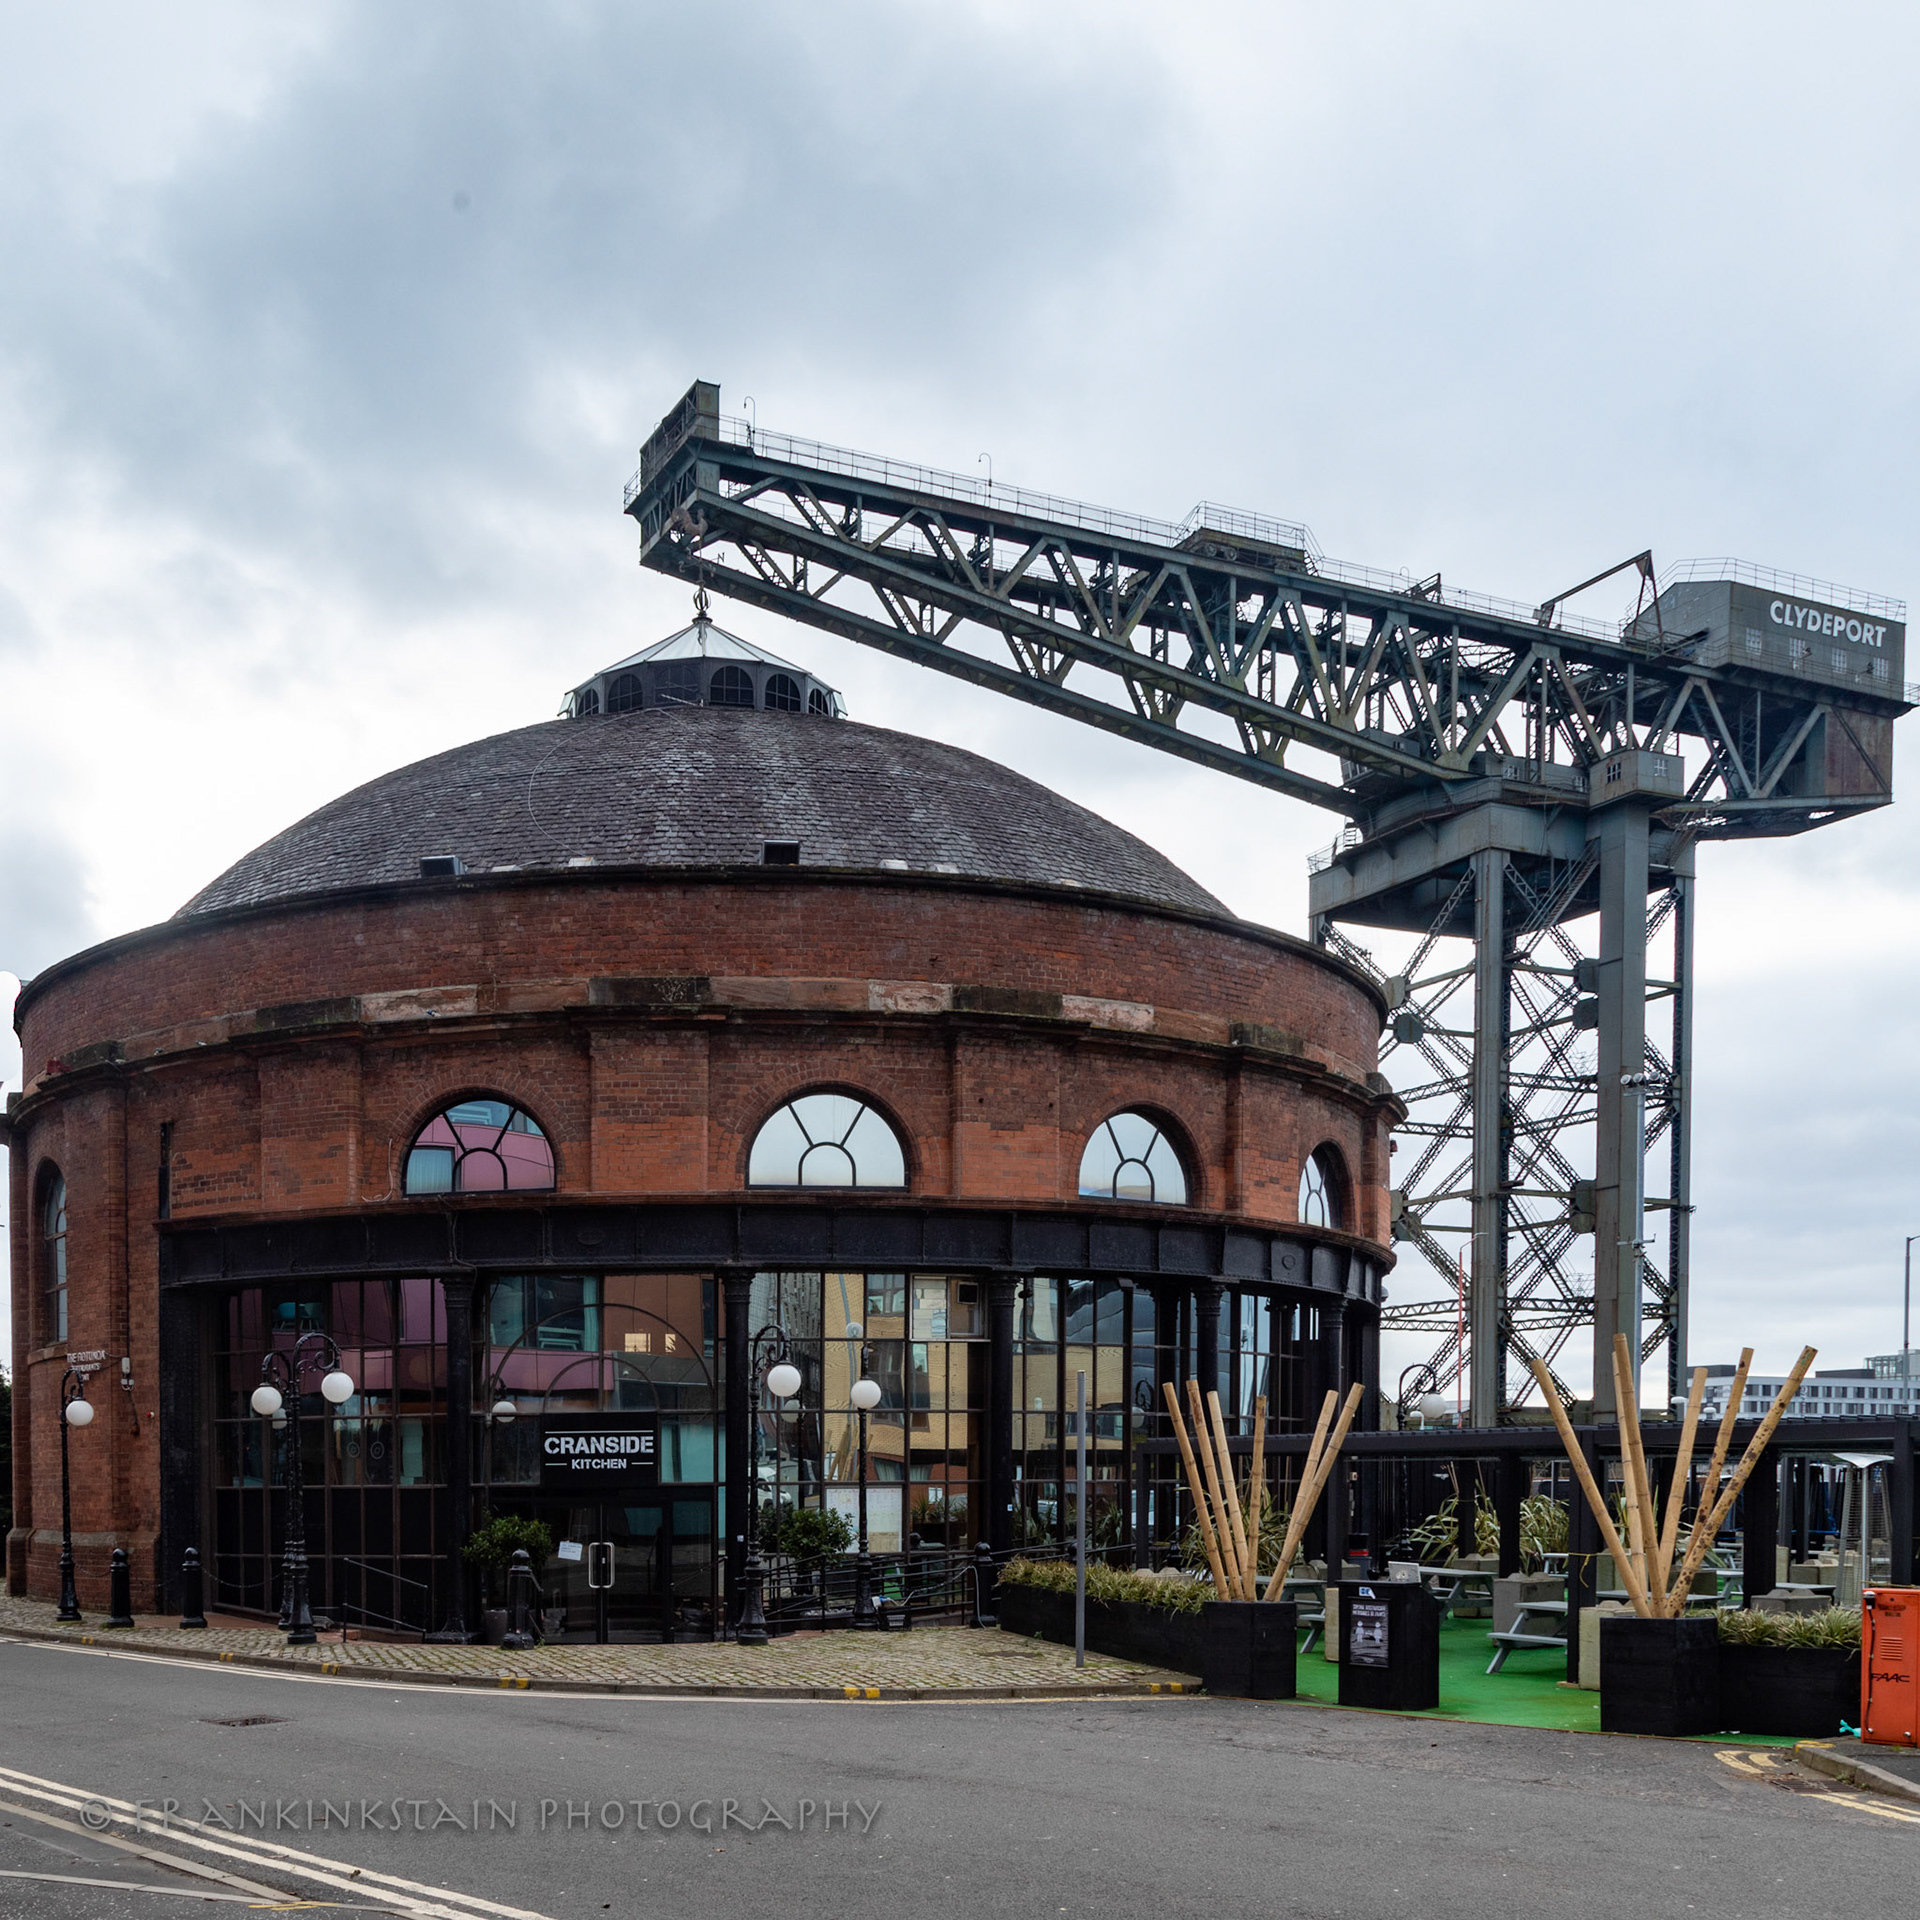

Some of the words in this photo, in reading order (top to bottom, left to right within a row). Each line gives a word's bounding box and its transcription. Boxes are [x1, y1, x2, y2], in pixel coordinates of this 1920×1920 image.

[1770, 600, 1886, 648] CLYDEPORT
[544, 1436, 654, 1454] CRANSIDE
[571, 1458, 627, 1469] KITCHEN
[1871, 1672, 1910, 1683] FAAC
